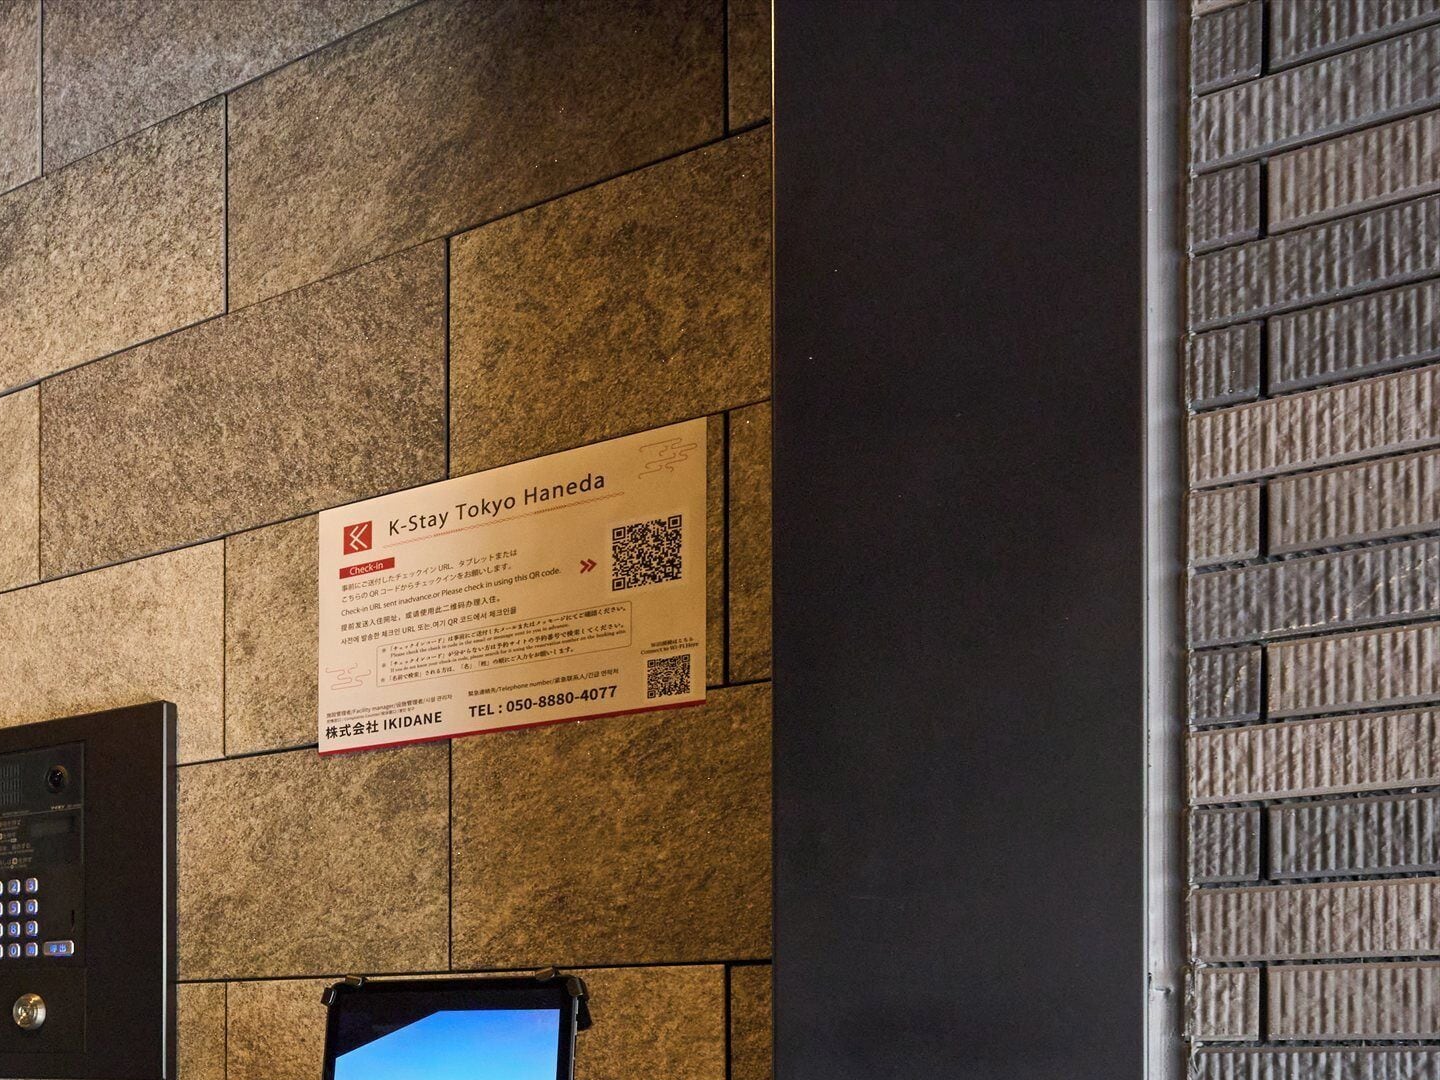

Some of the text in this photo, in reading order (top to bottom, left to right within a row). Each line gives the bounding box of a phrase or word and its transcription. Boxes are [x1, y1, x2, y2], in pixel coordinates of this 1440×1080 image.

[388, 473, 605, 536] K-Stay Tokyo Haneda
[349, 560, 383, 575] Check-in
[341, 605, 367, 616] Check-in
[370, 602, 381, 611] URL
[383, 600, 396, 608] sent
[441, 586, 462, 597] Please
[464, 582, 483, 592] check
[493, 576, 512, 588] using
[514, 573, 526, 583] this
[529, 570, 539, 580] QR
[541, 566, 560, 577] code.
[342, 591, 367, 603] こちらの
[369, 589, 378, 597] QR
[340, 635, 359, 645] 사전에
[402, 624, 414, 634] URL
[448, 617, 457, 625] QR
[468, 703, 494, 717] TEL
[506, 685, 616, 712] 050-8880-4077
[326, 719, 378, 739] 株式会社
[384, 711, 441, 730] IKIDANE
